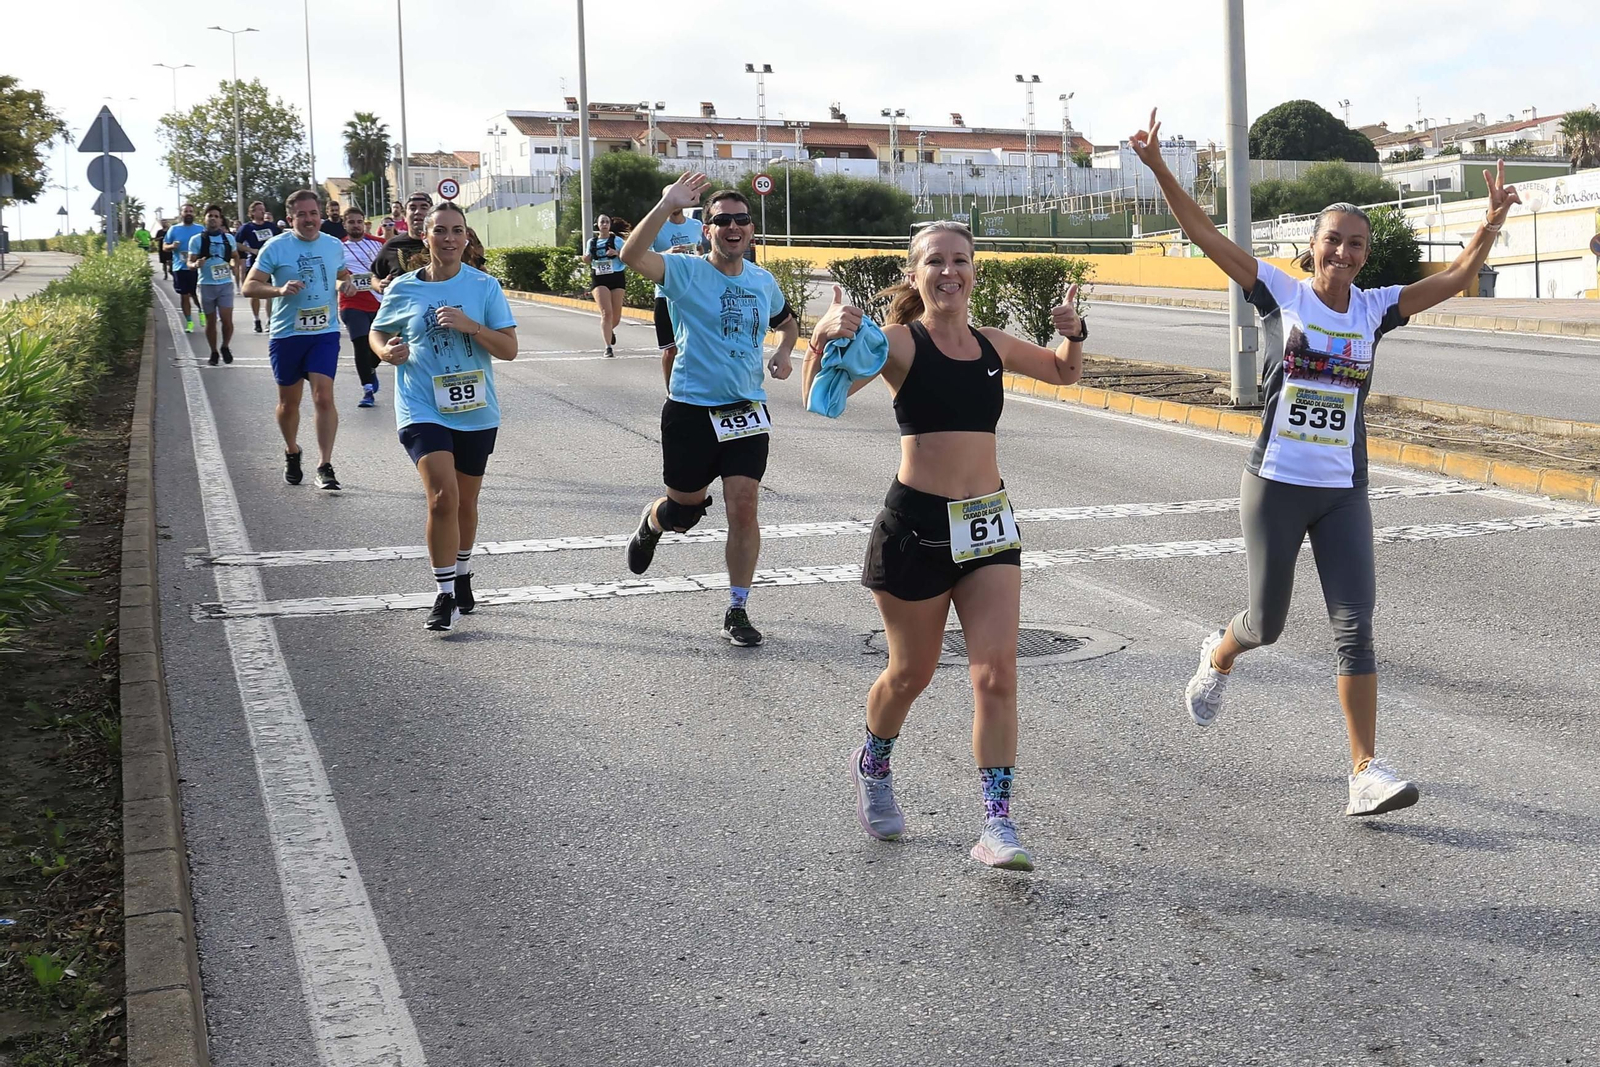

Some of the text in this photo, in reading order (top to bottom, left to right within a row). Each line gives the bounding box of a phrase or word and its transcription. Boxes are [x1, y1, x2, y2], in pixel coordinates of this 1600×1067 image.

[442, 185, 456, 193] 50
[757, 180, 770, 189] 50
[598, 263, 611, 271] 152
[299, 314, 327, 326] 113
[449, 384, 475, 401] 89
[1296, 392, 1345, 404] CARRERA URBANA
[1295, 398, 1315, 407] CIUDAD
[1321, 402, 1345, 410] ALGECIRAS
[720, 411, 761, 429] 491
[1288, 403, 1346, 431] 539
[962, 502, 988, 514] CARRERA
[962, 511, 982, 521] CIUDAD
[982, 509, 988, 517] DE
[970, 513, 1005, 541] 61
